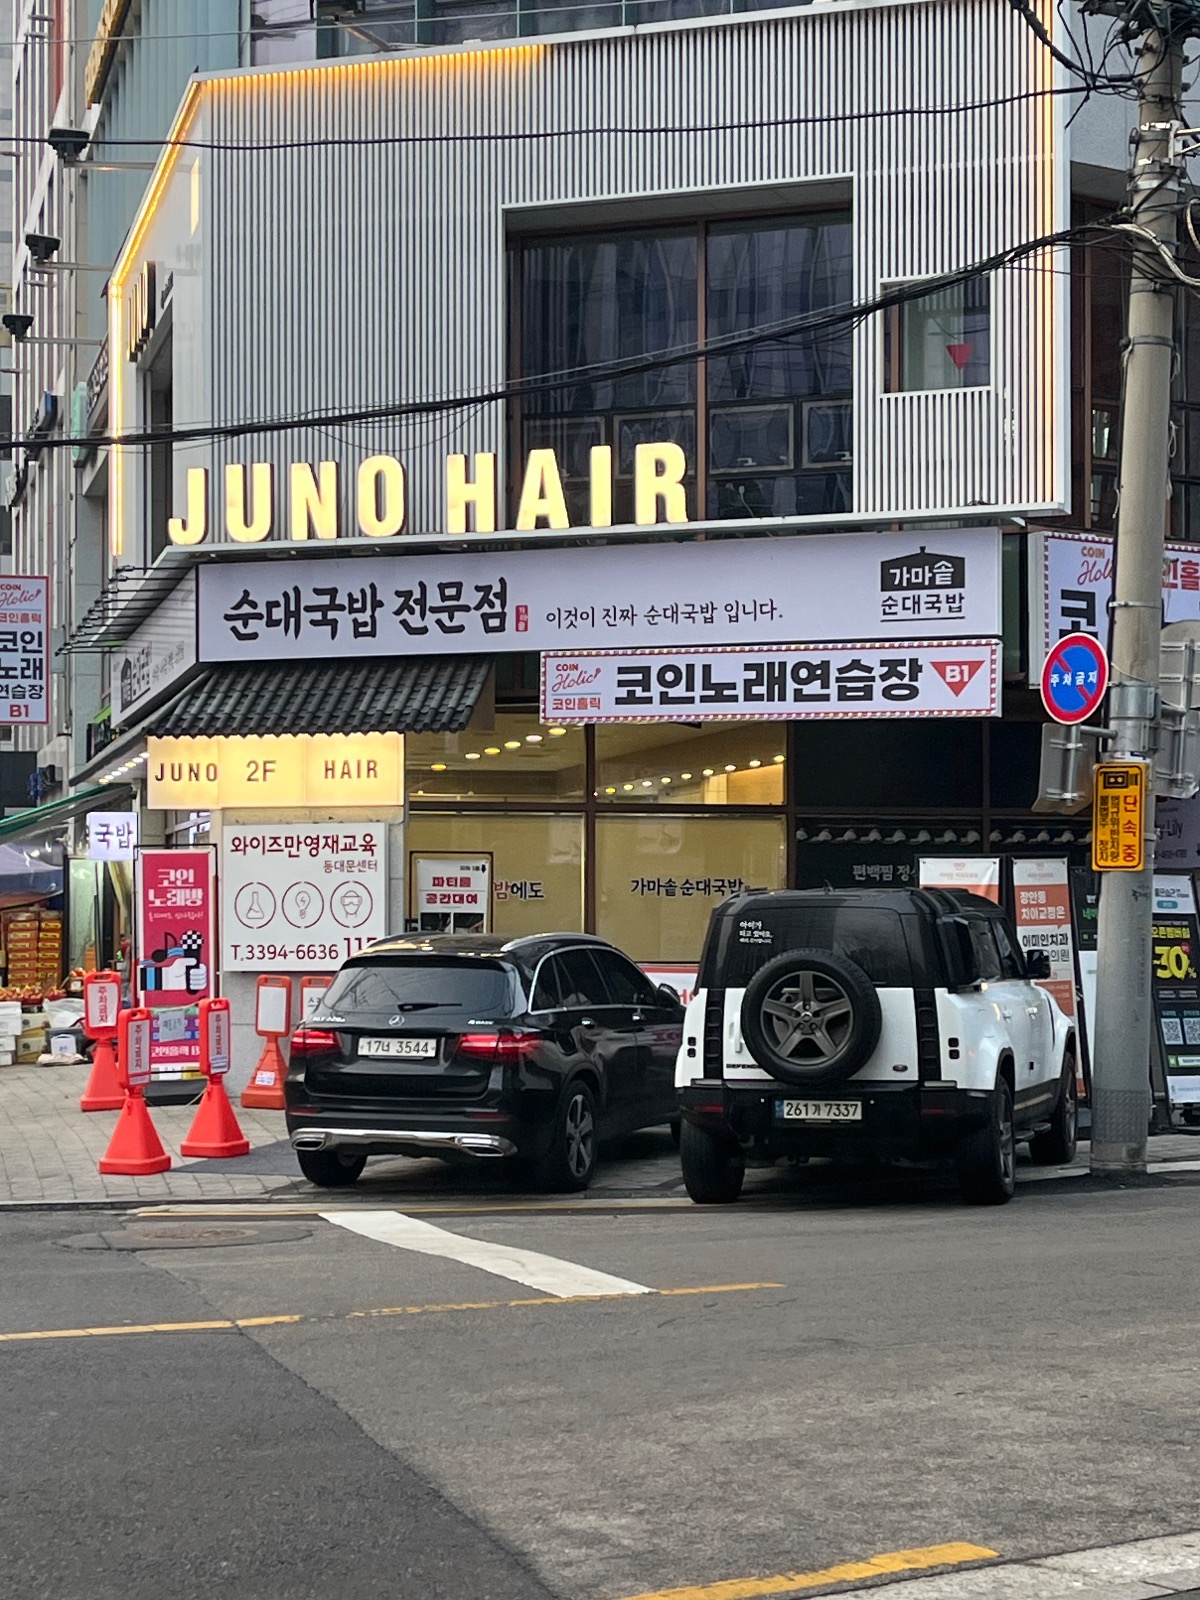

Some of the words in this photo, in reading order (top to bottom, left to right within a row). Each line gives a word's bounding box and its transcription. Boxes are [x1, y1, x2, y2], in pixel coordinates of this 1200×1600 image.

[168, 455, 405, 545] JUNO
[447, 442, 688, 534] HAIR
[1081, 546, 1105, 558] COIN
[889, 560, 954, 586] 가마솥
[223, 582, 384, 641] 순대국밥
[392, 576, 507, 636] 전문점
[546, 606, 596, 629] 이것이
[602, 604, 638, 627] 진짜
[643, 601, 718, 626] 순대국밥
[724, 598, 784, 624] 입니다.
[881, 593, 965, 616] 순대국밥
[0, 631, 43, 654] 코인
[0, 658, 43, 680] 노래
[555, 663, 579, 672] COIN
[946, 665, 969, 683] B1
[552, 668, 600, 692] Holic
[615, 658, 922, 706] 코인노래연습장
[1050, 670, 1097, 687] 주차금지
[0, 684, 44, 700] 연습장
[9, 704, 29, 717] B1
[552, 697, 601, 711] 코인홀릭
[155, 762, 218, 782] JUNO
[246, 759, 277, 782] 2F
[324, 759, 379, 780] HAIR
[94, 821, 134, 849] 국밥
[323, 860, 378, 873] 동대문센터
[853, 864, 893, 881] 편백찜
[157, 869, 195, 887] 코인
[148, 888, 204, 907] 노래방
[426, 893, 478, 904] 공간대여
[1020, 890, 1046, 905] 장안동
[231, 944, 339, 961] T.3394-6636
[344, 937, 378, 959] 11
[1022, 932, 1069, 948] 이미인치과
[395, 1040, 429, 1054] 3544
[824, 1103, 859, 1117] 7337
